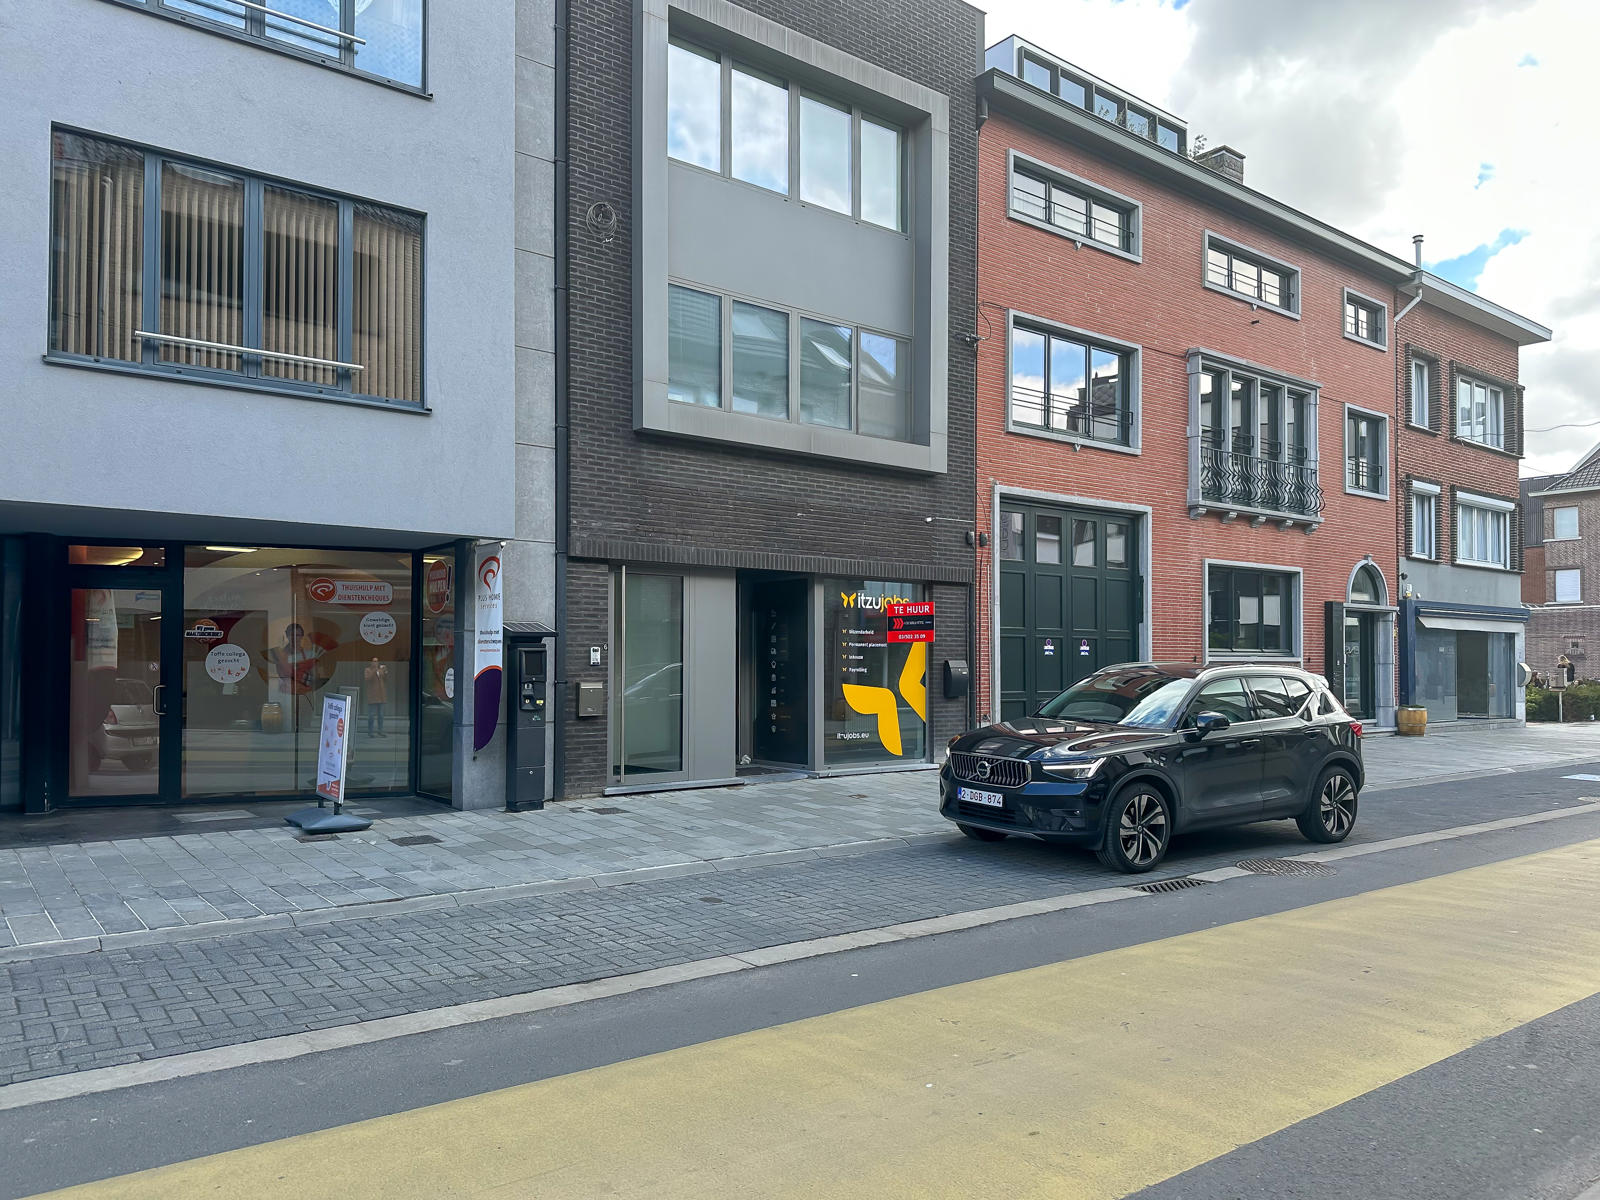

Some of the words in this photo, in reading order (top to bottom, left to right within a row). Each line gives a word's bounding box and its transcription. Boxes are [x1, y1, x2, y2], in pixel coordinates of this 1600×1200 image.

[342, 584, 373, 592] THUISHULP
[374, 584, 385, 592] MET
[337, 594, 390, 602] DIENSTENCHEQUES
[893, 606, 904, 614] TE
[906, 605, 930, 614] HUUR
